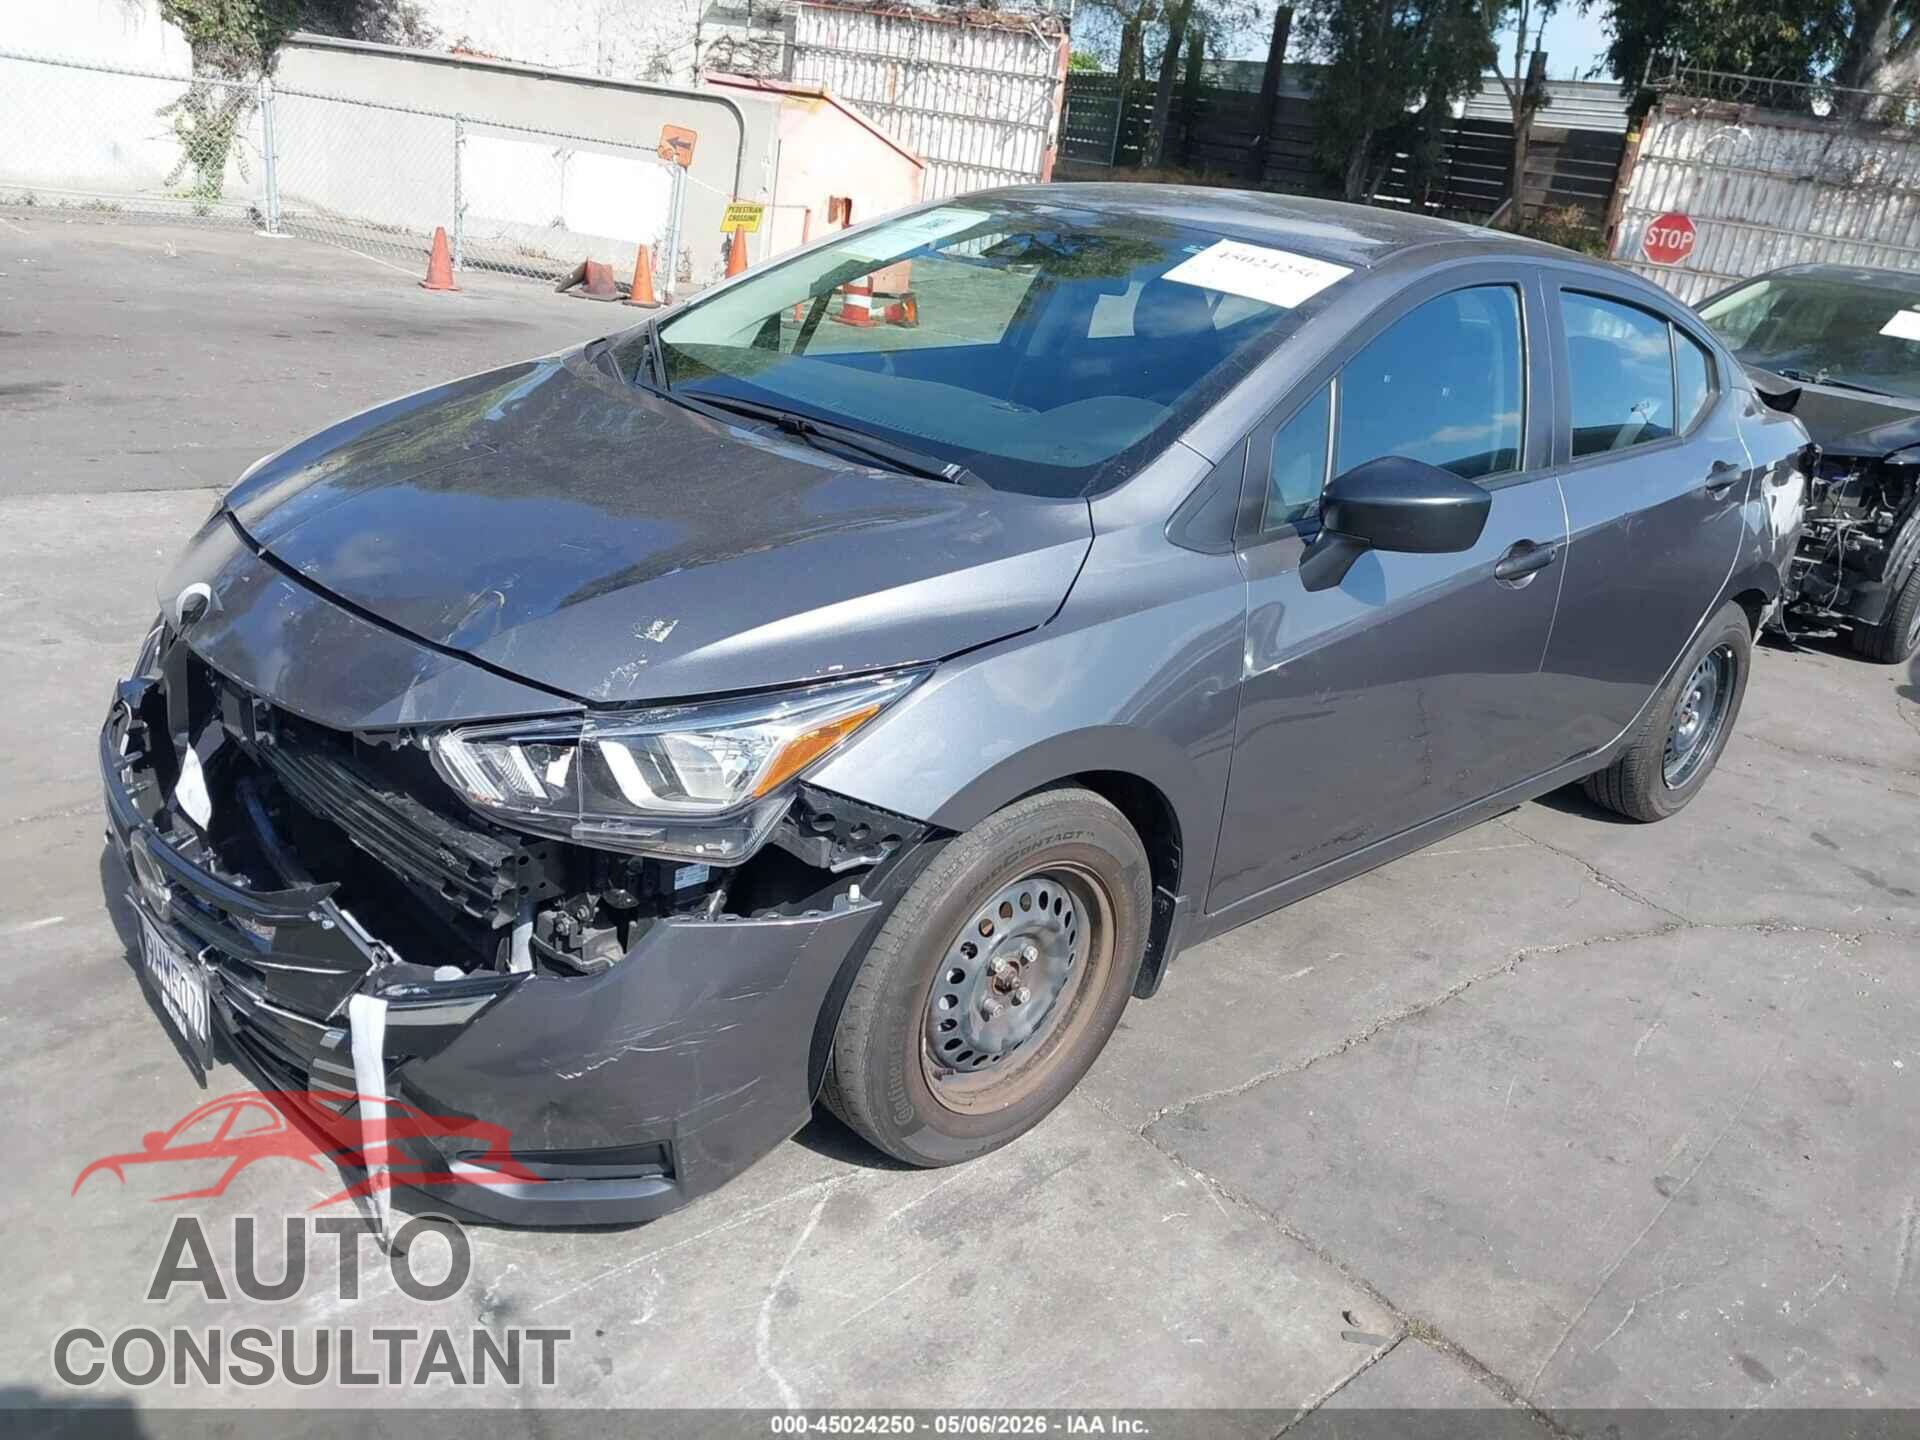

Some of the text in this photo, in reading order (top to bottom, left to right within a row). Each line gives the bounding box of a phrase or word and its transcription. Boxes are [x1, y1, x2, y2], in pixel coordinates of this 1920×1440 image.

[727, 206, 763, 214] PEDESTRIAN
[727, 214, 757, 222] CROSSING
[1645, 227, 1694, 250] STOP
